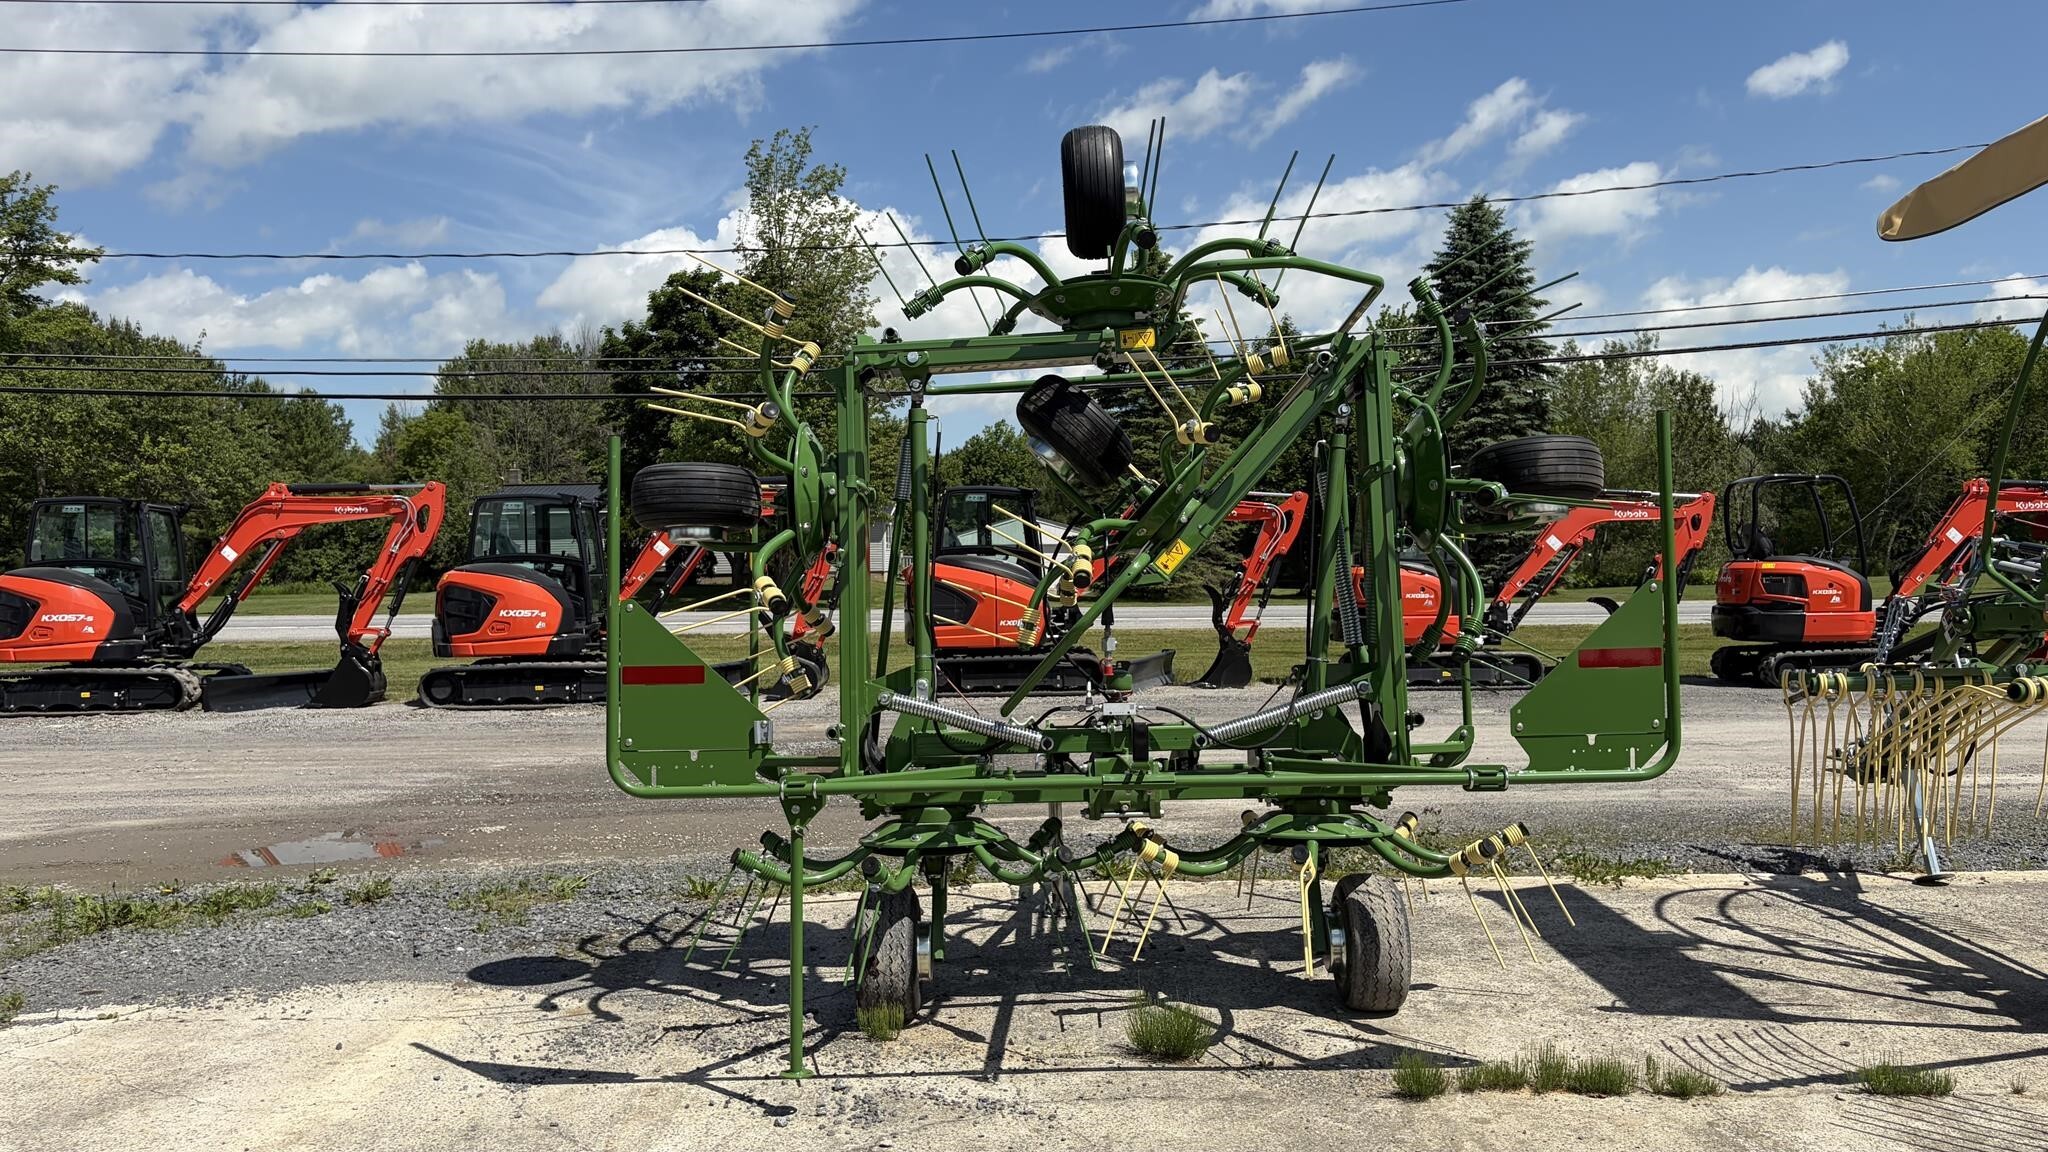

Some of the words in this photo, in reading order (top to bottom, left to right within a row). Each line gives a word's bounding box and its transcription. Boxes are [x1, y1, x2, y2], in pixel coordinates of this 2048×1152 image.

[334, 505, 369, 514] Kubota
[2015, 500, 2048, 510] Kubota
[1614, 509, 1649, 518] Kubota
